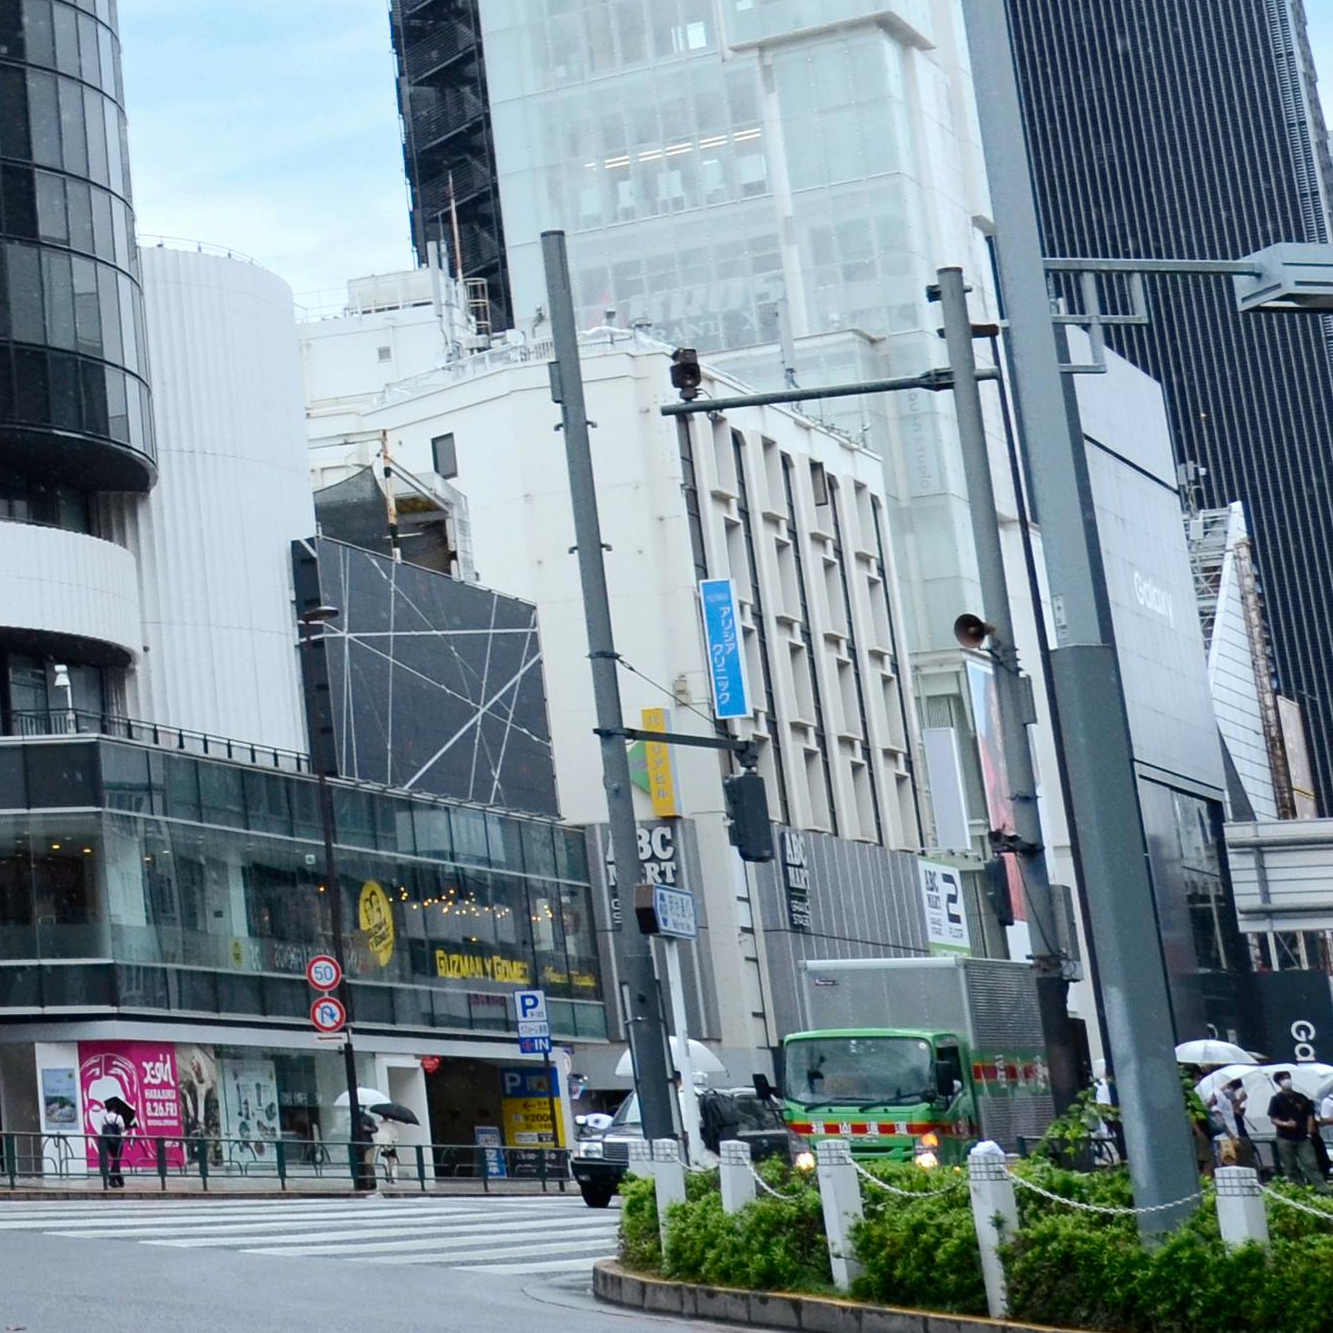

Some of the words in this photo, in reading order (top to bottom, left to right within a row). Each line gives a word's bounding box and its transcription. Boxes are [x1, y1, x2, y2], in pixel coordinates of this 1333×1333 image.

[1133, 570, 1174, 629] Galaxy
[719, 606, 736, 655] アリシア
[712, 643, 731, 705] クリニック
[784, 832, 807, 866] ABC
[606, 861, 677, 887] RT
[941, 872, 963, 925] 2
[313, 965, 334, 981] 50
[435, 949, 484, 979] GUZMAN
[484, 957, 492, 982] Y
[520, 994, 540, 1018] P
[534, 1038, 550, 1051] IN
[503, 1072, 522, 1094] P
[146, 1101, 179, 1117] 8.26.FRI
